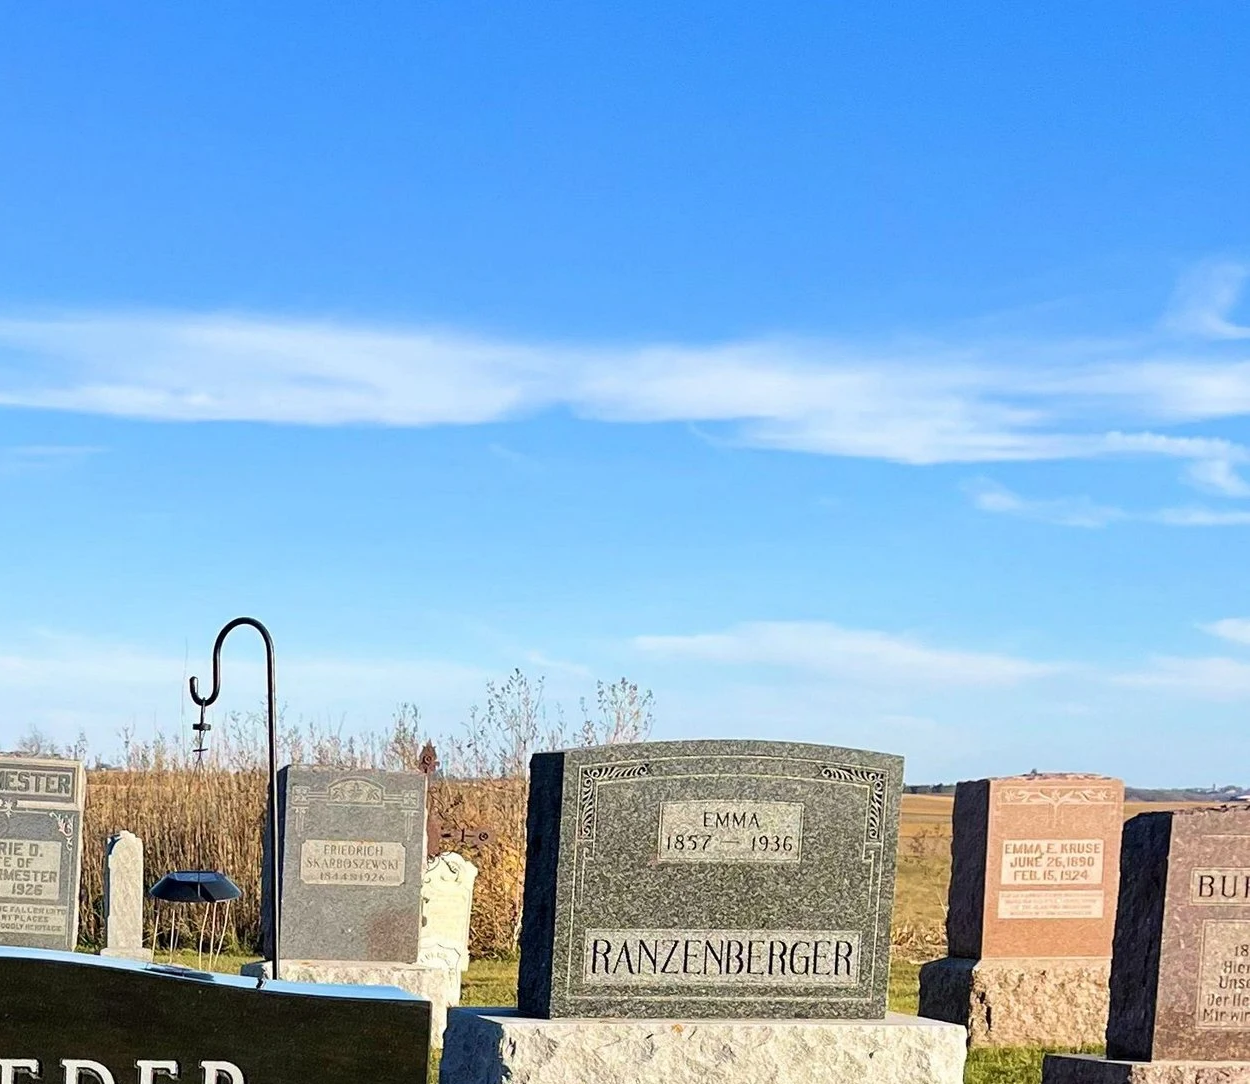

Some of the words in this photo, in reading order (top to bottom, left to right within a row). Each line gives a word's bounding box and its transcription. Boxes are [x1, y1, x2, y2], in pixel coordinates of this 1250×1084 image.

[703, 811, 760, 828] EMMA
[666, 835, 712, 851] 1857
[751, 836, 794, 852] 1936
[1005, 843, 1042, 854] EMMA
[1061, 843, 1101, 854] KRUSE
[324, 845, 383, 857] FRIEDRICH
[17, 857, 34, 868] OF
[1010, 857, 1043, 868] JUNE
[360, 873, 385, 882] 1926
[1061, 870, 1088, 881] 1924
[11, 883, 43, 896] 1926
[591, 939, 852, 976] RANZENBERGER
